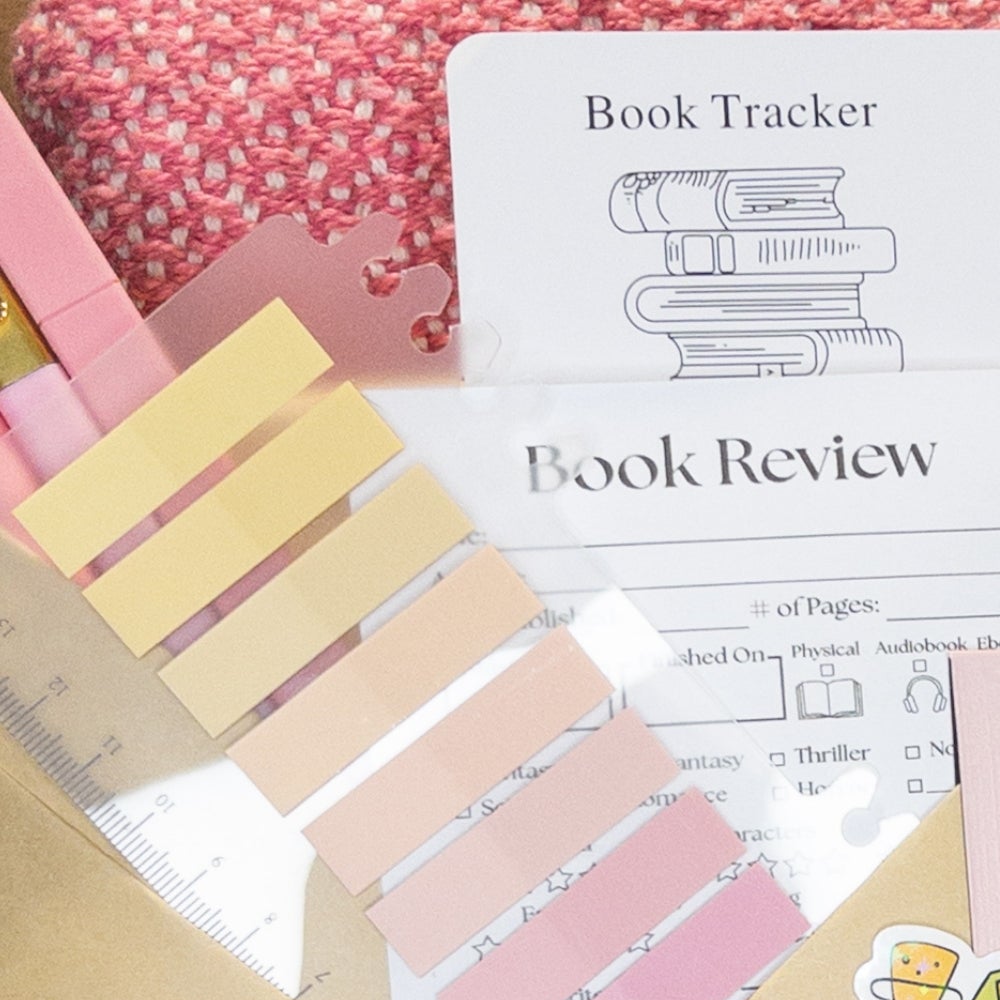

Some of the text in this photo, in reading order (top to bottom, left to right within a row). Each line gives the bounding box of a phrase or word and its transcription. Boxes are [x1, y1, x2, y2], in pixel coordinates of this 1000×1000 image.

[584, 93, 878, 131] Book Tracker
[525, 434, 938, 494] Book Review
[777, 596, 804, 617] of
[806, 597, 880, 621] Pages:
[733, 646, 765, 665] On
[791, 641, 860, 662] Physical
[875, 636, 968, 655] Audiobook
[49, 676, 69, 697] 12
[103, 735, 122, 756] 11
[794, 743, 871, 764] Thriller
[675, 747, 744, 772] antasy
